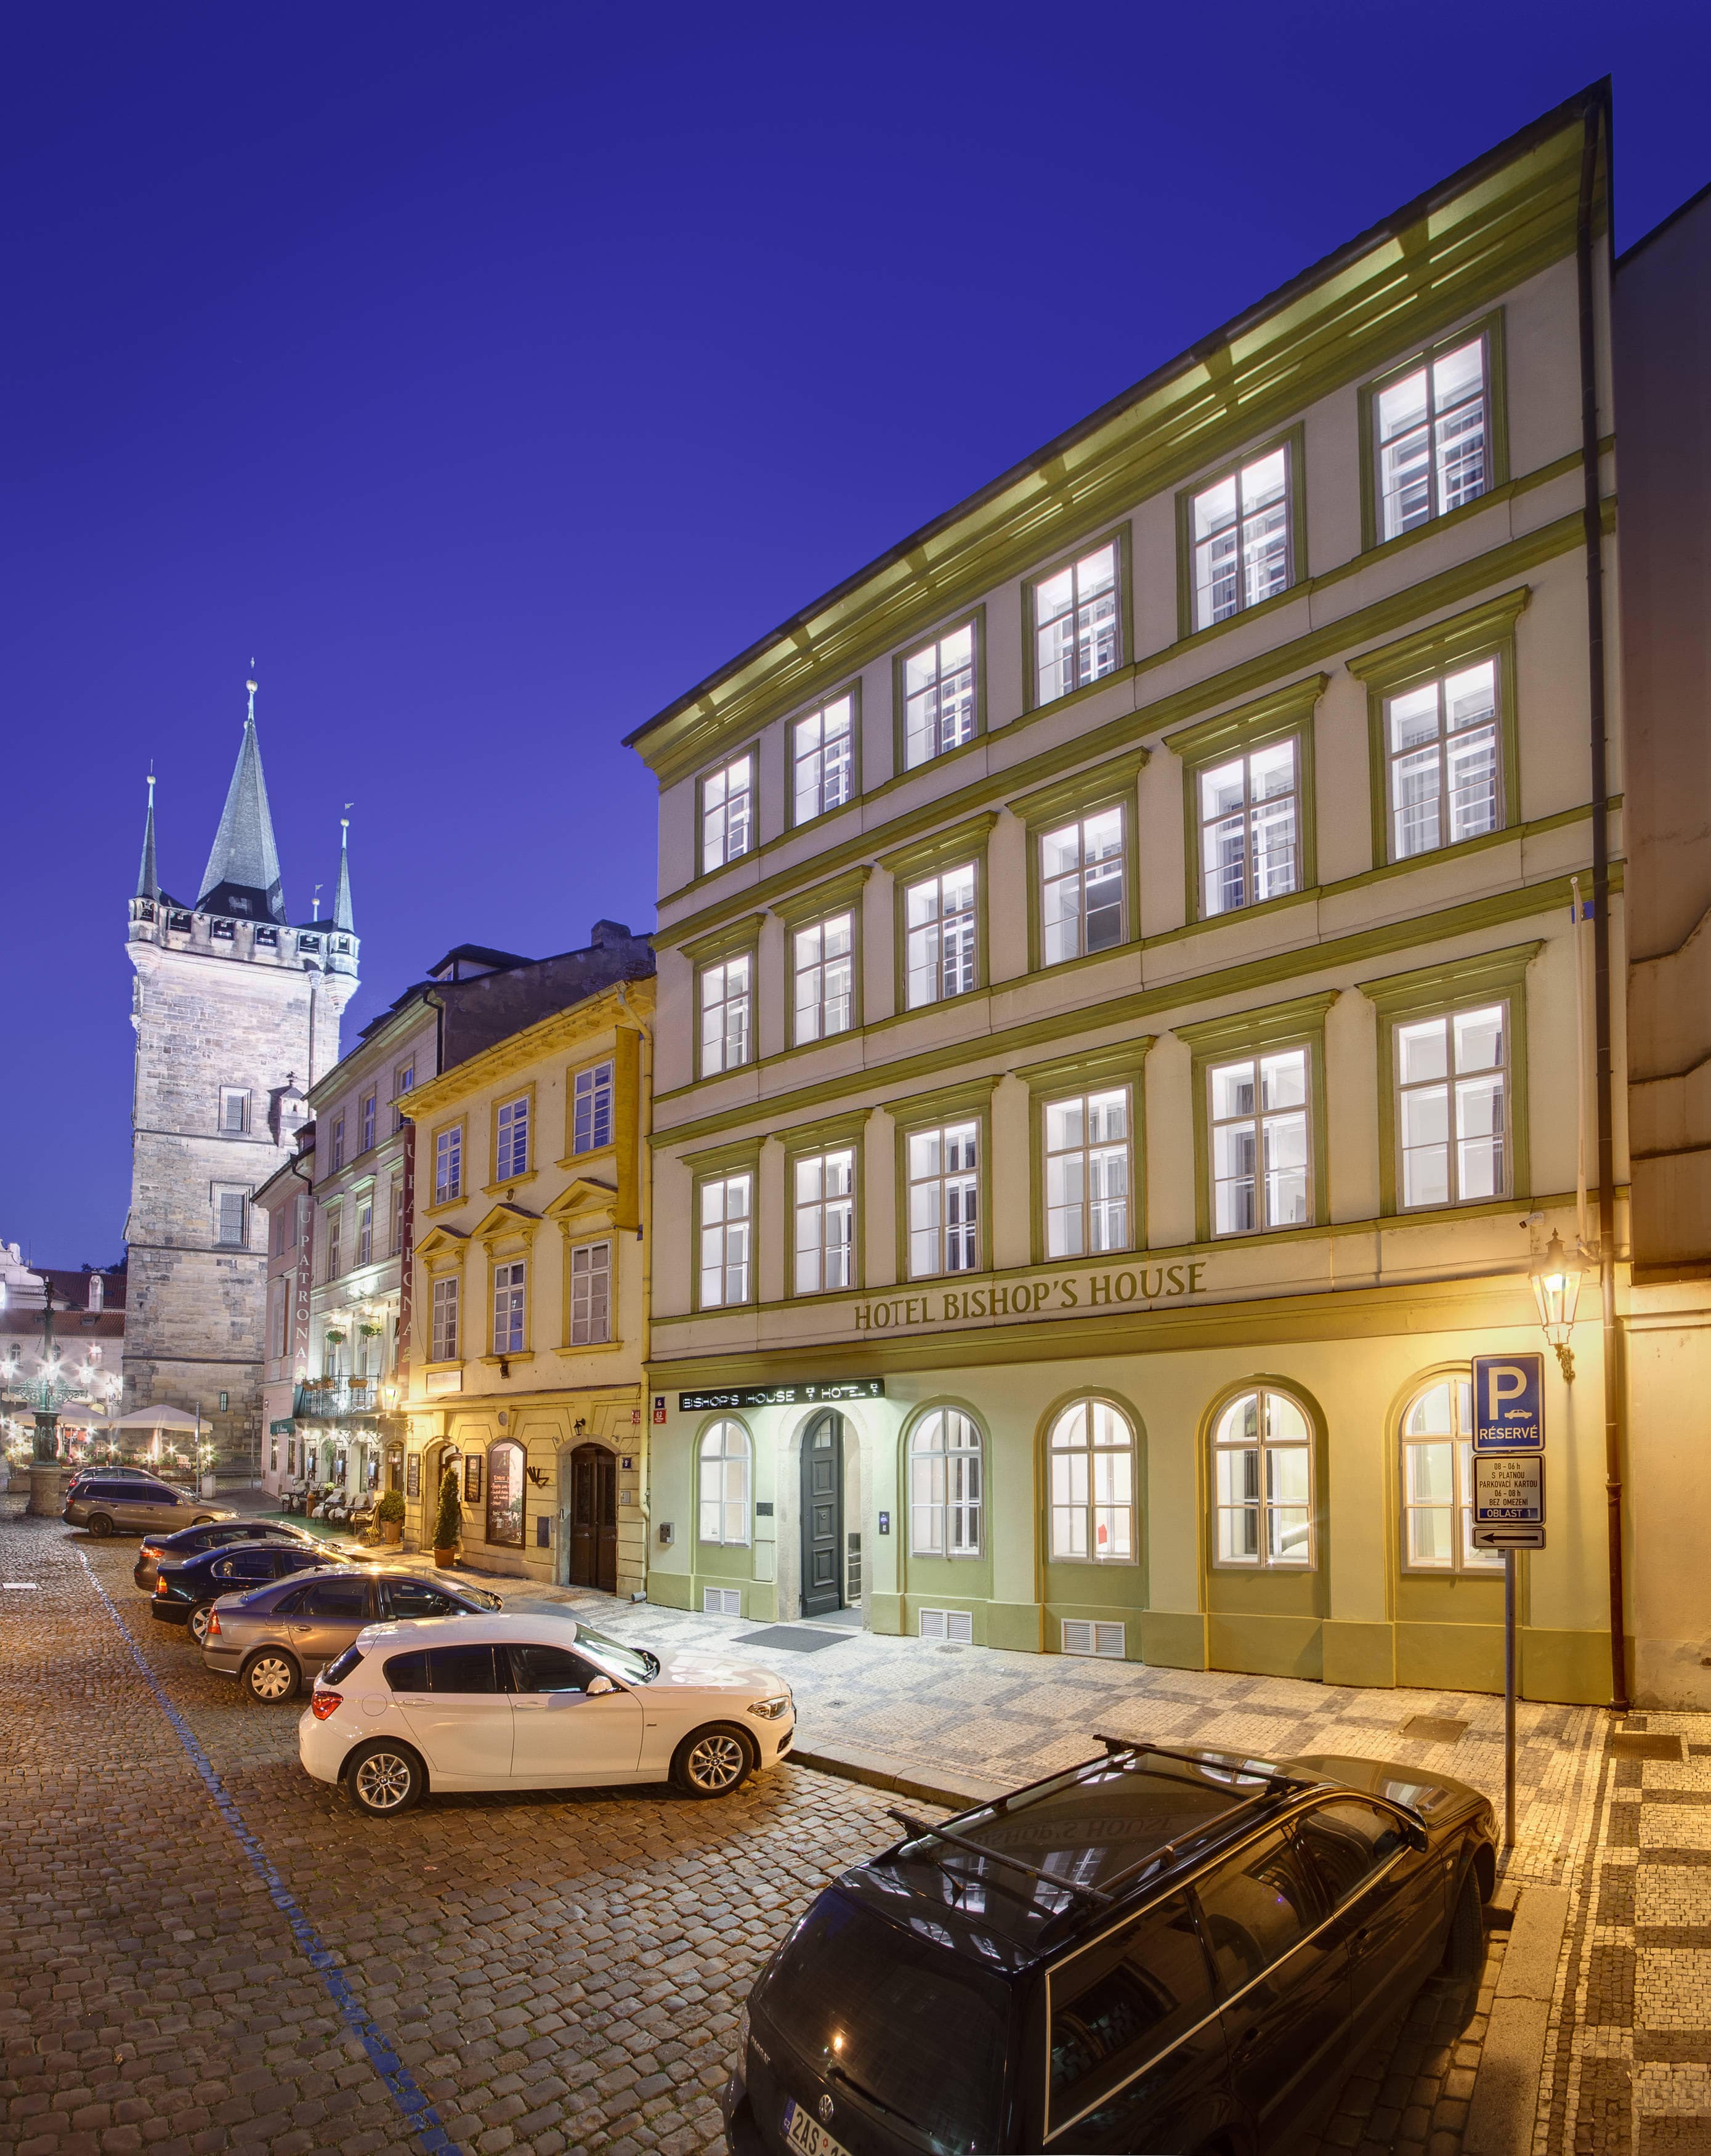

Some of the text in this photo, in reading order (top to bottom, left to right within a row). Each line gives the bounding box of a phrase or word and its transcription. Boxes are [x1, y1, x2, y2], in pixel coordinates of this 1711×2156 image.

[295, 1212, 311, 1358] U PATRONA
[854, 1262, 1207, 1330] HOTEL BISHOP'S HOUSE
[682, 1386, 866, 1409] BISHOP'S HOUSE HOTEL
[1488, 1366, 1527, 1420] P
[1479, 1424, 1538, 1440] RÉSERVÉ
[1494, 1462, 1502, 1470] 08
[1499, 1471, 1525, 1479] PLATNOU
[1479, 1479, 1538, 1488] PARKOVACÍ KARTOU
[1489, 1497, 1528, 1506] BEZ OMEZENÍ
[1487, 1509, 1531, 1518] OBLAST 1
[783, 2117, 791, 2130] CZ
